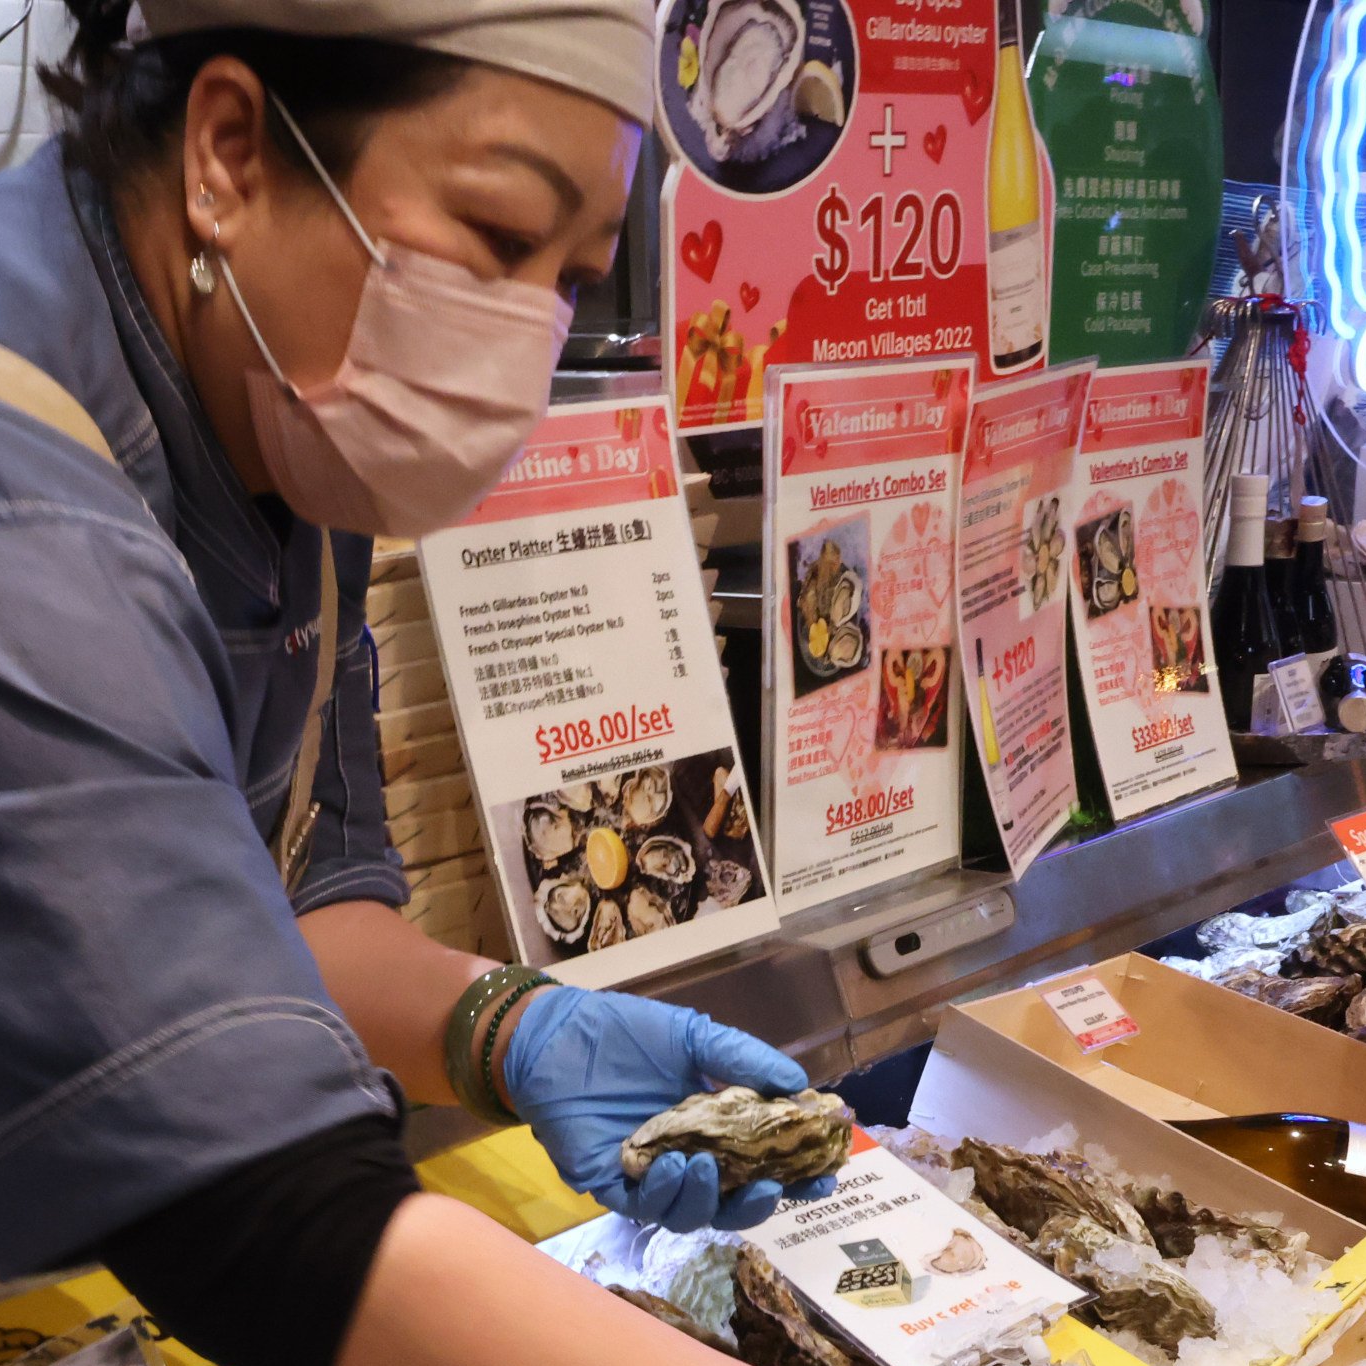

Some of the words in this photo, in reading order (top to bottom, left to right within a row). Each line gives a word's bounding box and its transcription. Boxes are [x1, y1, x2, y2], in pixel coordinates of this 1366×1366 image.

[866, 16, 942, 42] Gillardeau
[943, 23, 989, 48] oyster
[813, 182, 962, 296] $120
[865, 296, 893, 322] Get
[813, 337, 867, 362] Macon
[871, 331, 931, 359] Villages
[935, 325, 973, 350] 2022
[913, 393, 947, 432] Day
[594, 444, 641, 473] Day
[1141, 451, 1172, 473] Combo
[1174, 450, 1189, 467] Set
[810, 476, 879, 508] Valentine's
[883, 470, 927, 498] Combo
[927, 468, 947, 492] Set
[460, 542, 507, 570] Oyster
[507, 536, 554, 562] Platter
[459, 601, 491, 618] French
[491, 592, 539, 612] Gillardeau
[539, 588, 569, 606] Oyster
[651, 570, 671, 585] 2pcs
[463, 620, 495, 638] French
[495, 612, 542, 632] Josephine
[542, 606, 571, 624] Oyster
[571, 602, 591, 616] Nr.1
[655, 588, 675, 602] 2pcs
[467, 640, 500, 657] French
[500, 632, 543, 652] Citysuper
[543, 624, 576, 644] Special
[575, 620, 605, 638] Oyster
[659, 606, 679, 621] 2pcs
[991, 635, 1036, 693] +$120
[533, 699, 675, 765] $308.00/set
[825, 784, 914, 837] $438.00/set
[829, 1171, 883, 1195] SPECIAL
[793, 1200, 845, 1226] OYSTER
